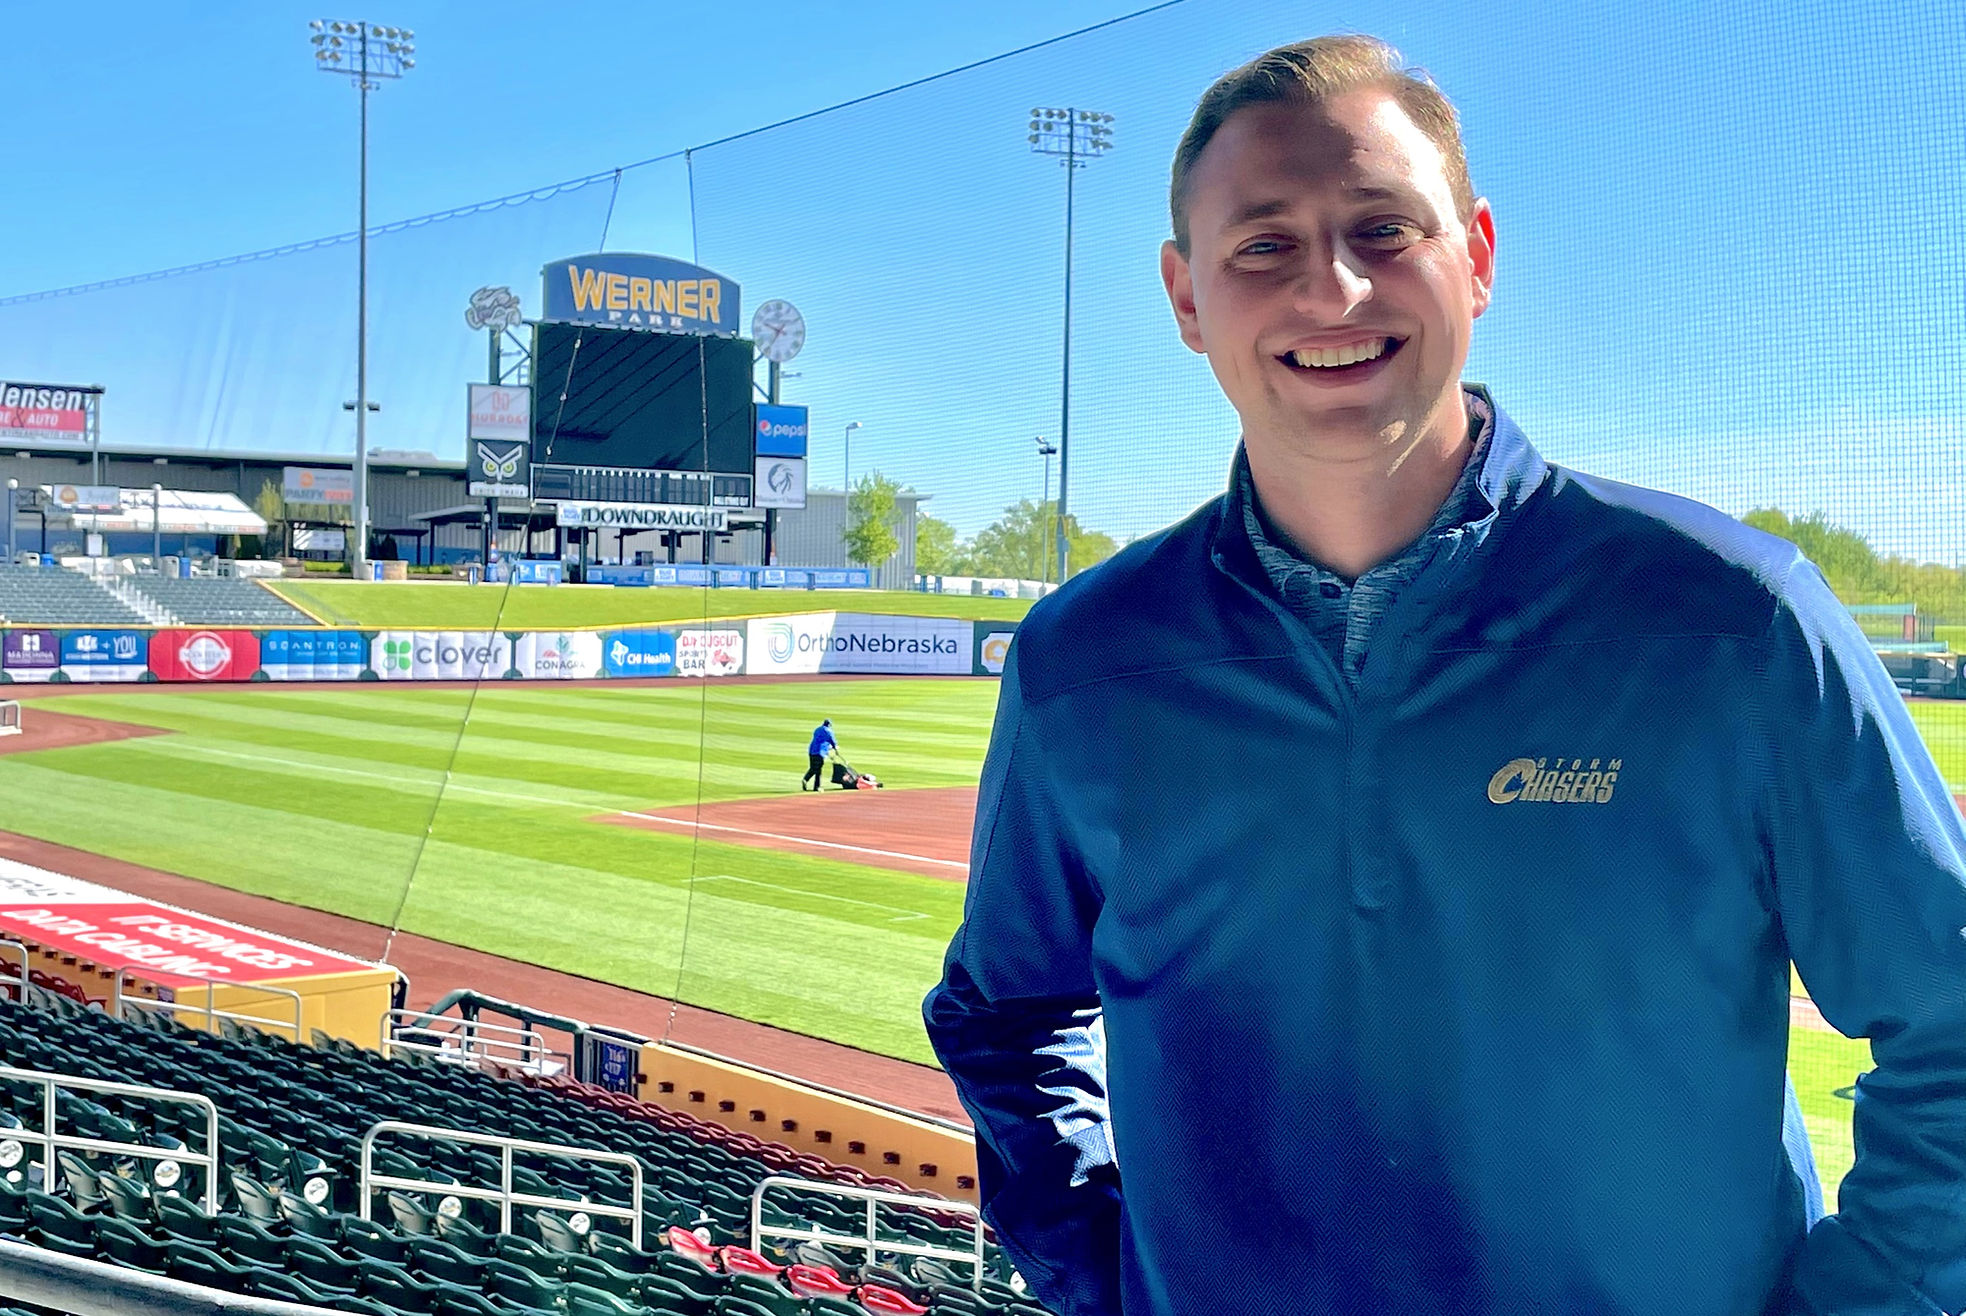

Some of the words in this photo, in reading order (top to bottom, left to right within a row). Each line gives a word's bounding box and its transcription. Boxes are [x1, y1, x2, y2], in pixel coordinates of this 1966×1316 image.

[568, 264, 720, 324] WERNER
[608, 310, 684, 328] PARK
[27, 413, 59, 427] AUTO
[773, 422, 807, 438] pepsi
[588, 507, 724, 528] DOWNDRAUGHT
[269, 641, 360, 650] SCANTRON
[416, 639, 502, 664] clover
[798, 633, 958, 654] OrthoNebraska
[627, 653, 642, 665] CHI
[643, 652, 671, 665] Health
[683, 659, 705, 670] BAR
[1537, 757, 1622, 770] STORM
[1487, 758, 1618, 804] CHASERS
